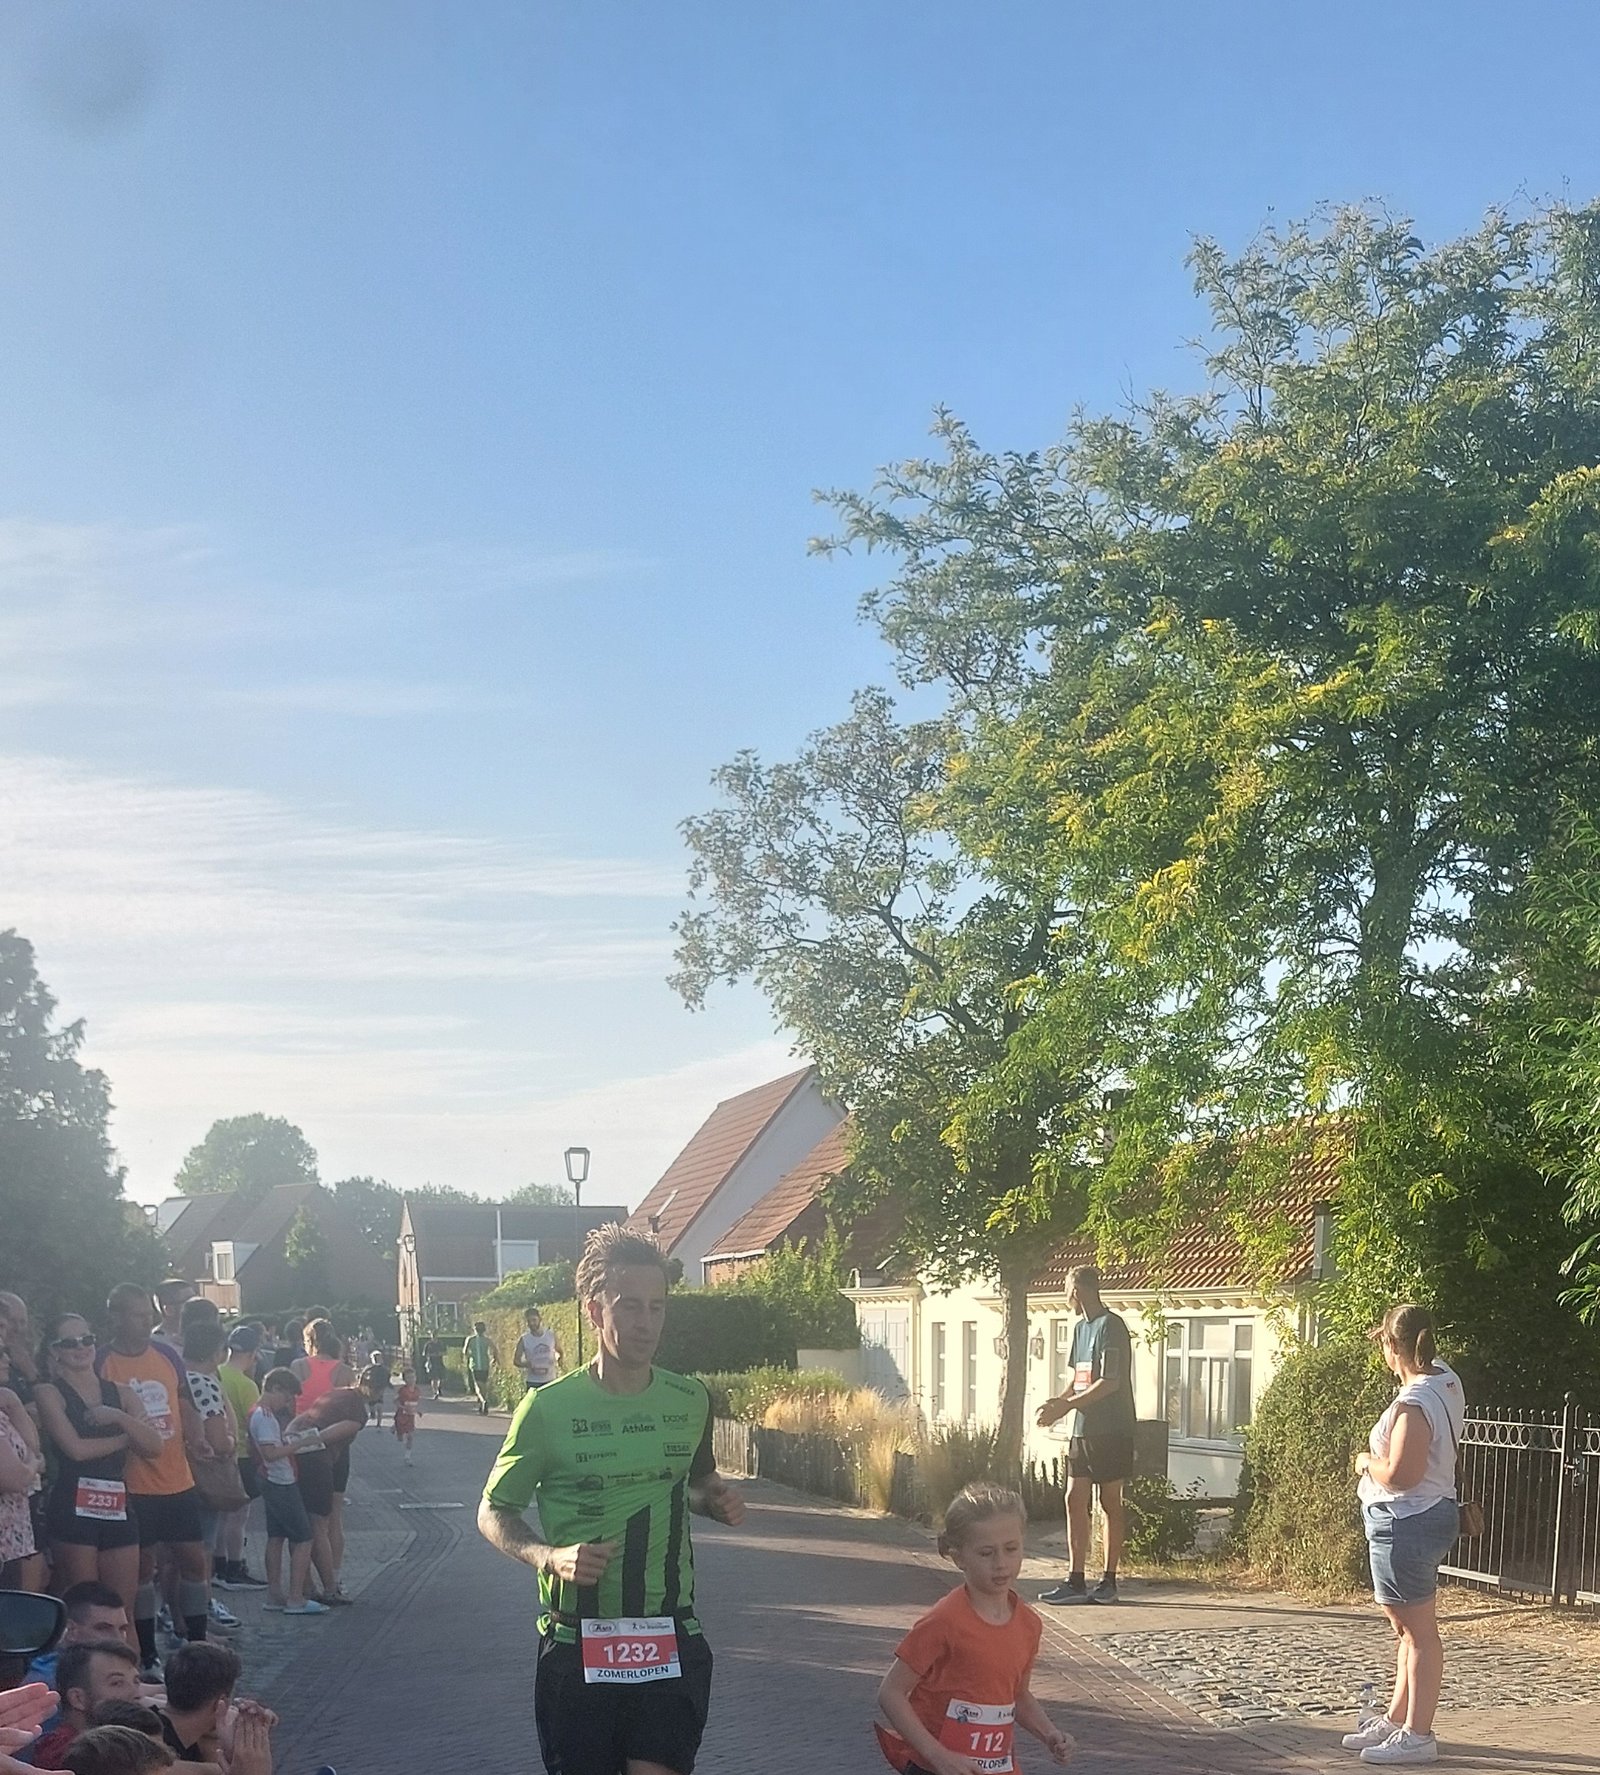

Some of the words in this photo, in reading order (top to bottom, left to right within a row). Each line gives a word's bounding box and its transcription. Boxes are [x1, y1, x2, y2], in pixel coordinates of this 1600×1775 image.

[622, 1423, 656, 1434] Athlex
[88, 1493, 118, 1508] 2331
[603, 1642, 660, 1664] 1232
[597, 1665, 669, 1679] ZOMERLOPEN
[970, 1731, 1004, 1752] 112
